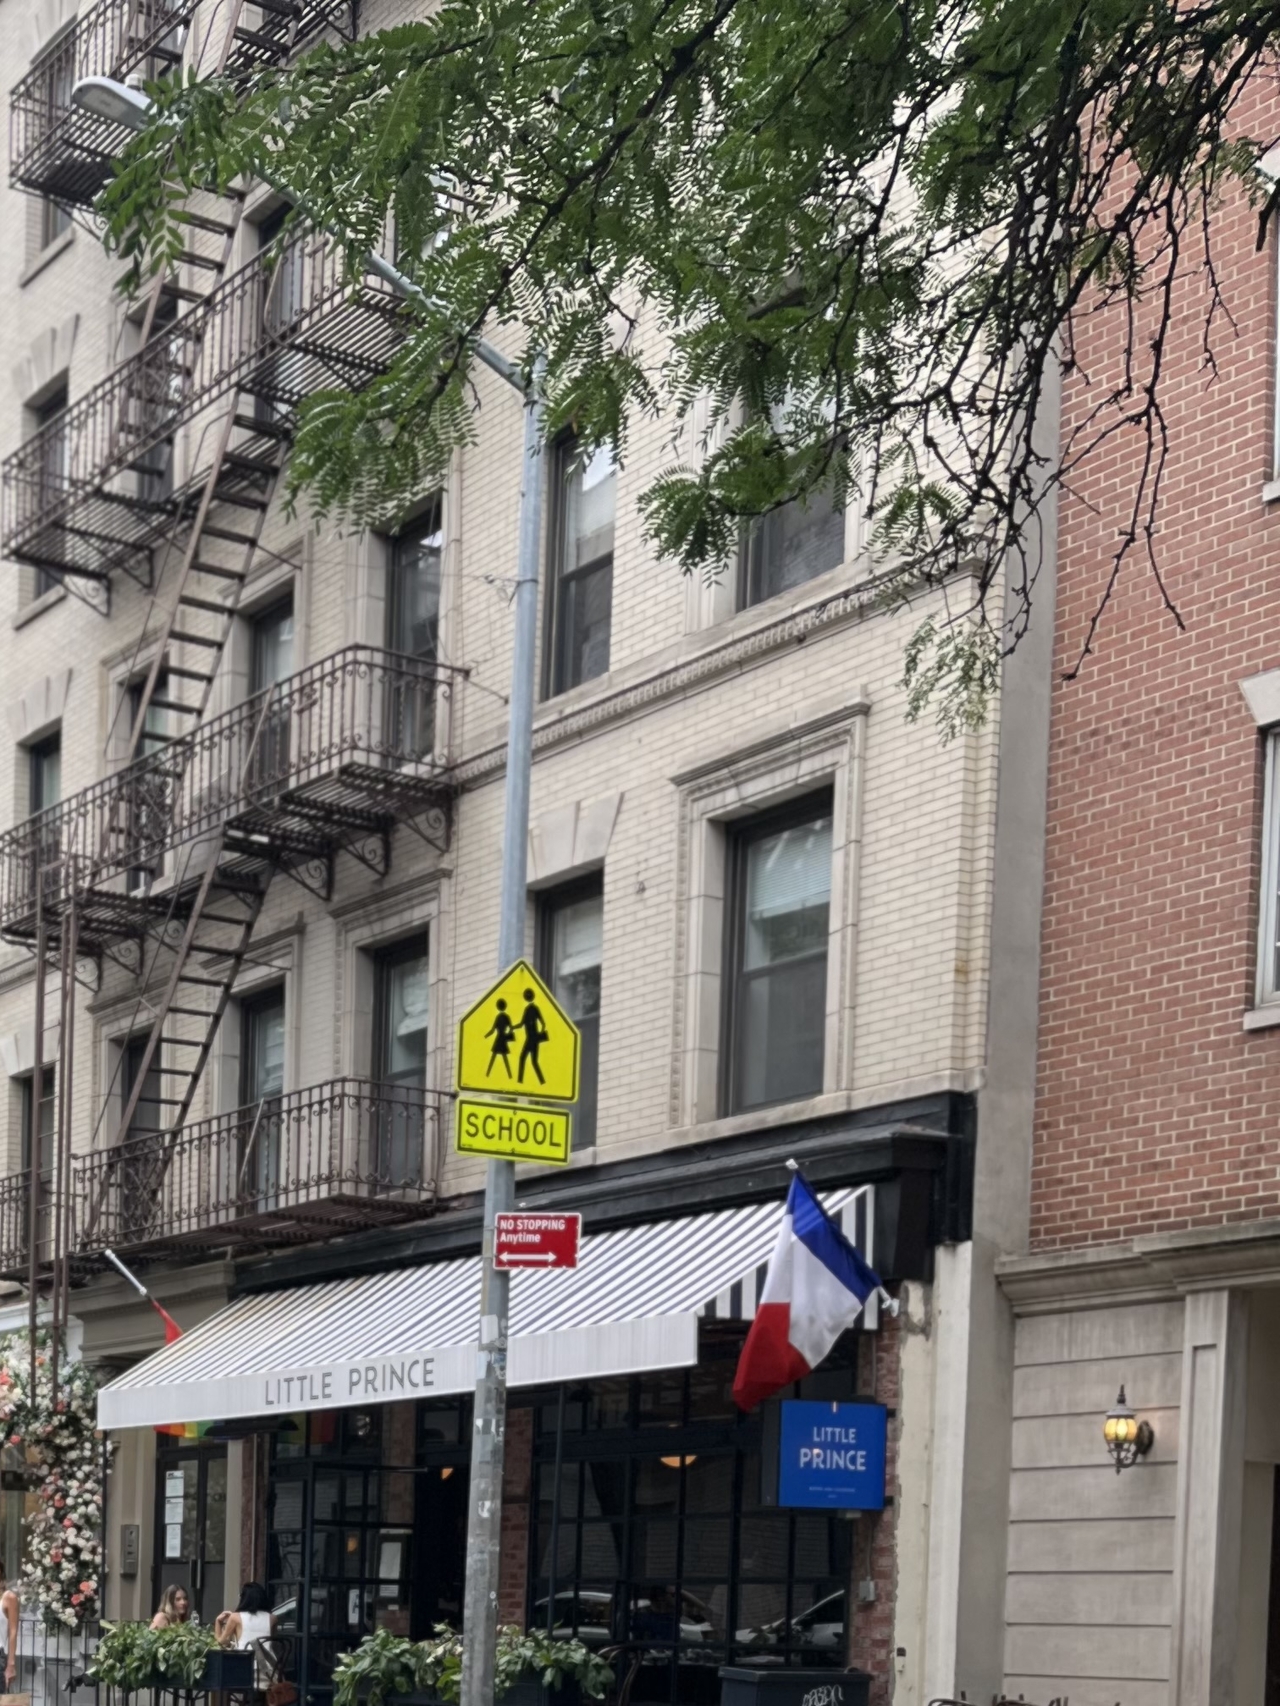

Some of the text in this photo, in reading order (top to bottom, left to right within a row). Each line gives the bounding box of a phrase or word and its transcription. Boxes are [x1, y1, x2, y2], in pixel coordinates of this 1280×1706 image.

[465, 1112, 562, 1148] SCHOOL
[500, 1219, 566, 1230] NO STOPPING
[500, 1232, 541, 1245] Anytime
[265, 1357, 435, 1406] LITTLE PRINCE
[813, 1426, 856, 1443] LITTLE
[800, 1448, 866, 1470] PRINCE
